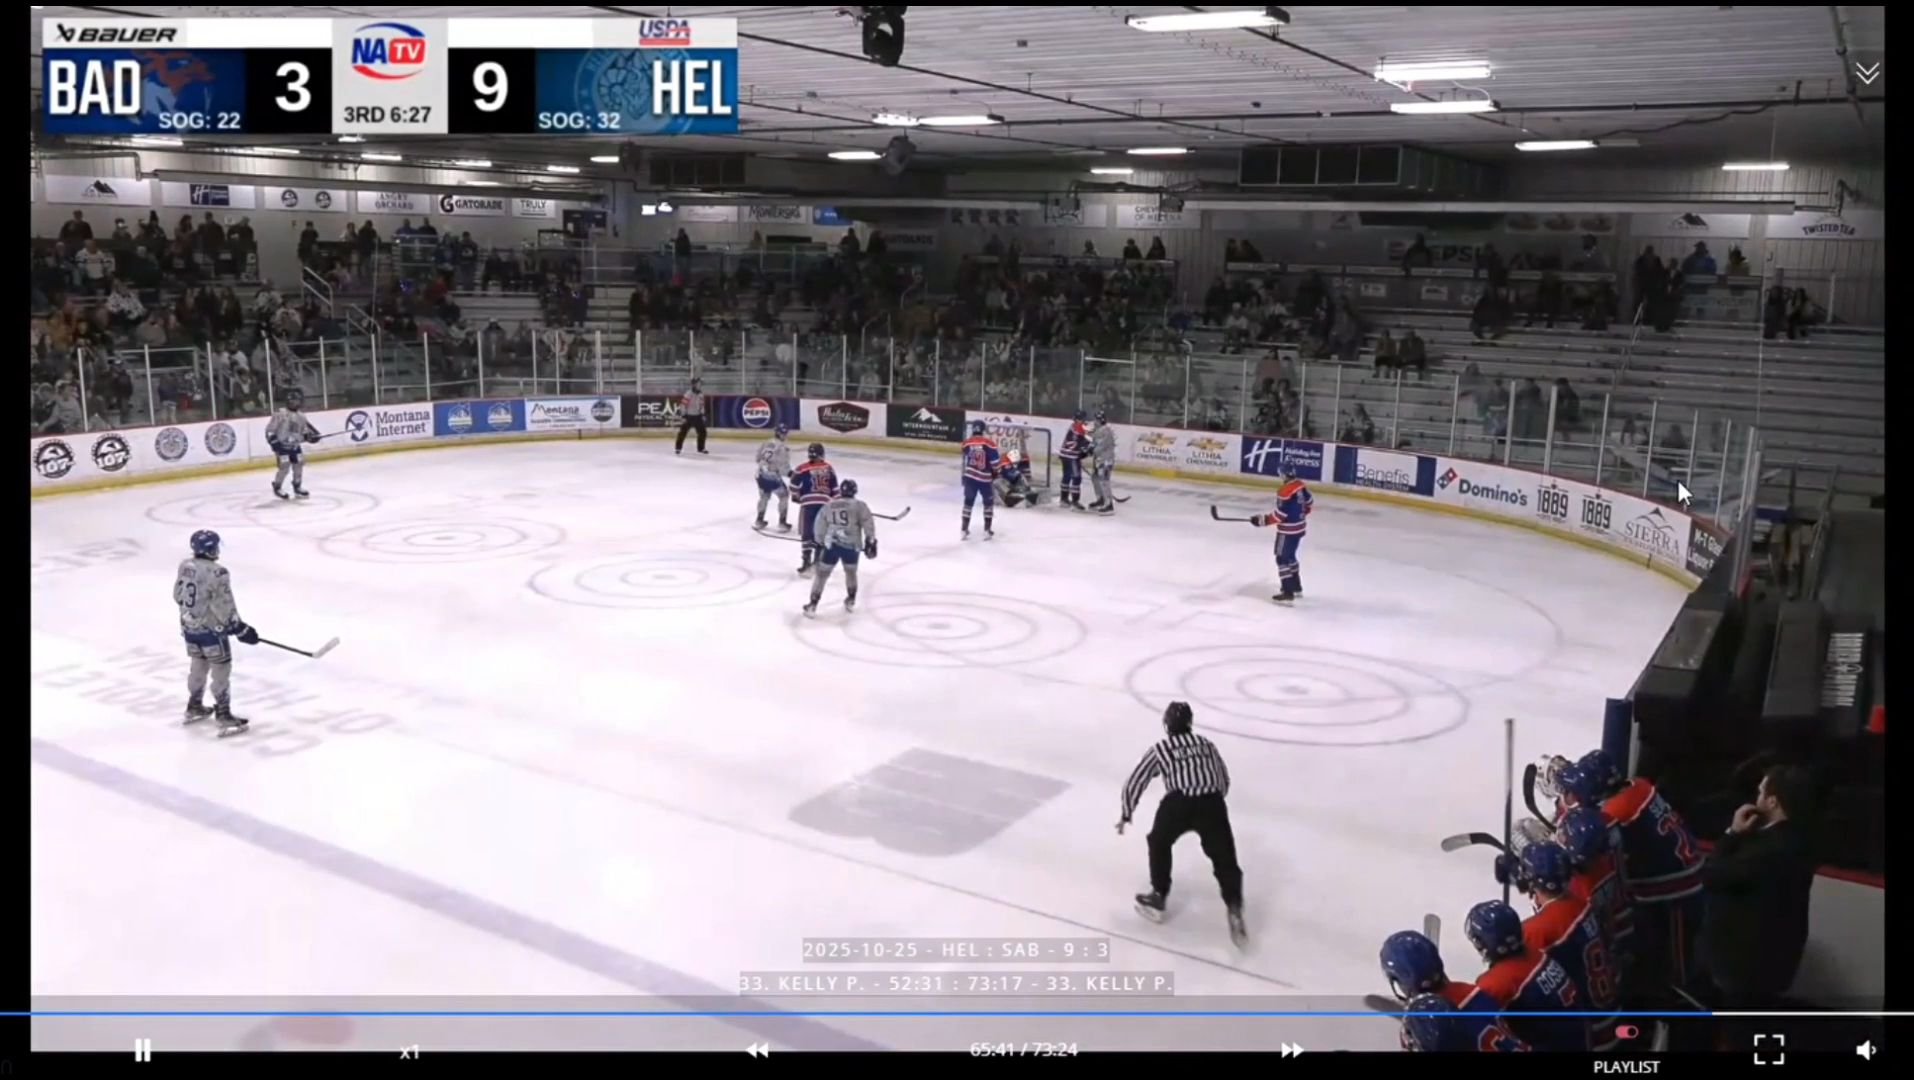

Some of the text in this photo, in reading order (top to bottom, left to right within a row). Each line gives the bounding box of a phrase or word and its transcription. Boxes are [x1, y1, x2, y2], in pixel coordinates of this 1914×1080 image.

[455, 198, 503, 211] GATORADE
[520, 199, 547, 210] TRULY
[1802, 223, 1856, 236] TWISTED TEA
[375, 409, 431, 424] Montana
[743, 408, 771, 417] PEPSI
[376, 421, 428, 437] Internet
[1136, 453, 1178, 463] CHEVROLET
[1142, 446, 1172, 456] LITHIA
[1192, 450, 1222, 461] LITHIA
[1186, 458, 1229, 468] CHEVROLET
[1356, 463, 1411, 485] Benefis
[1458, 478, 1529, 507] Domino's
[1536, 488, 1570, 518] 1889
[831, 510, 849, 526] 19
[1580, 498, 1612, 530] 1889
[1623, 520, 1682, 556] SIERRA
